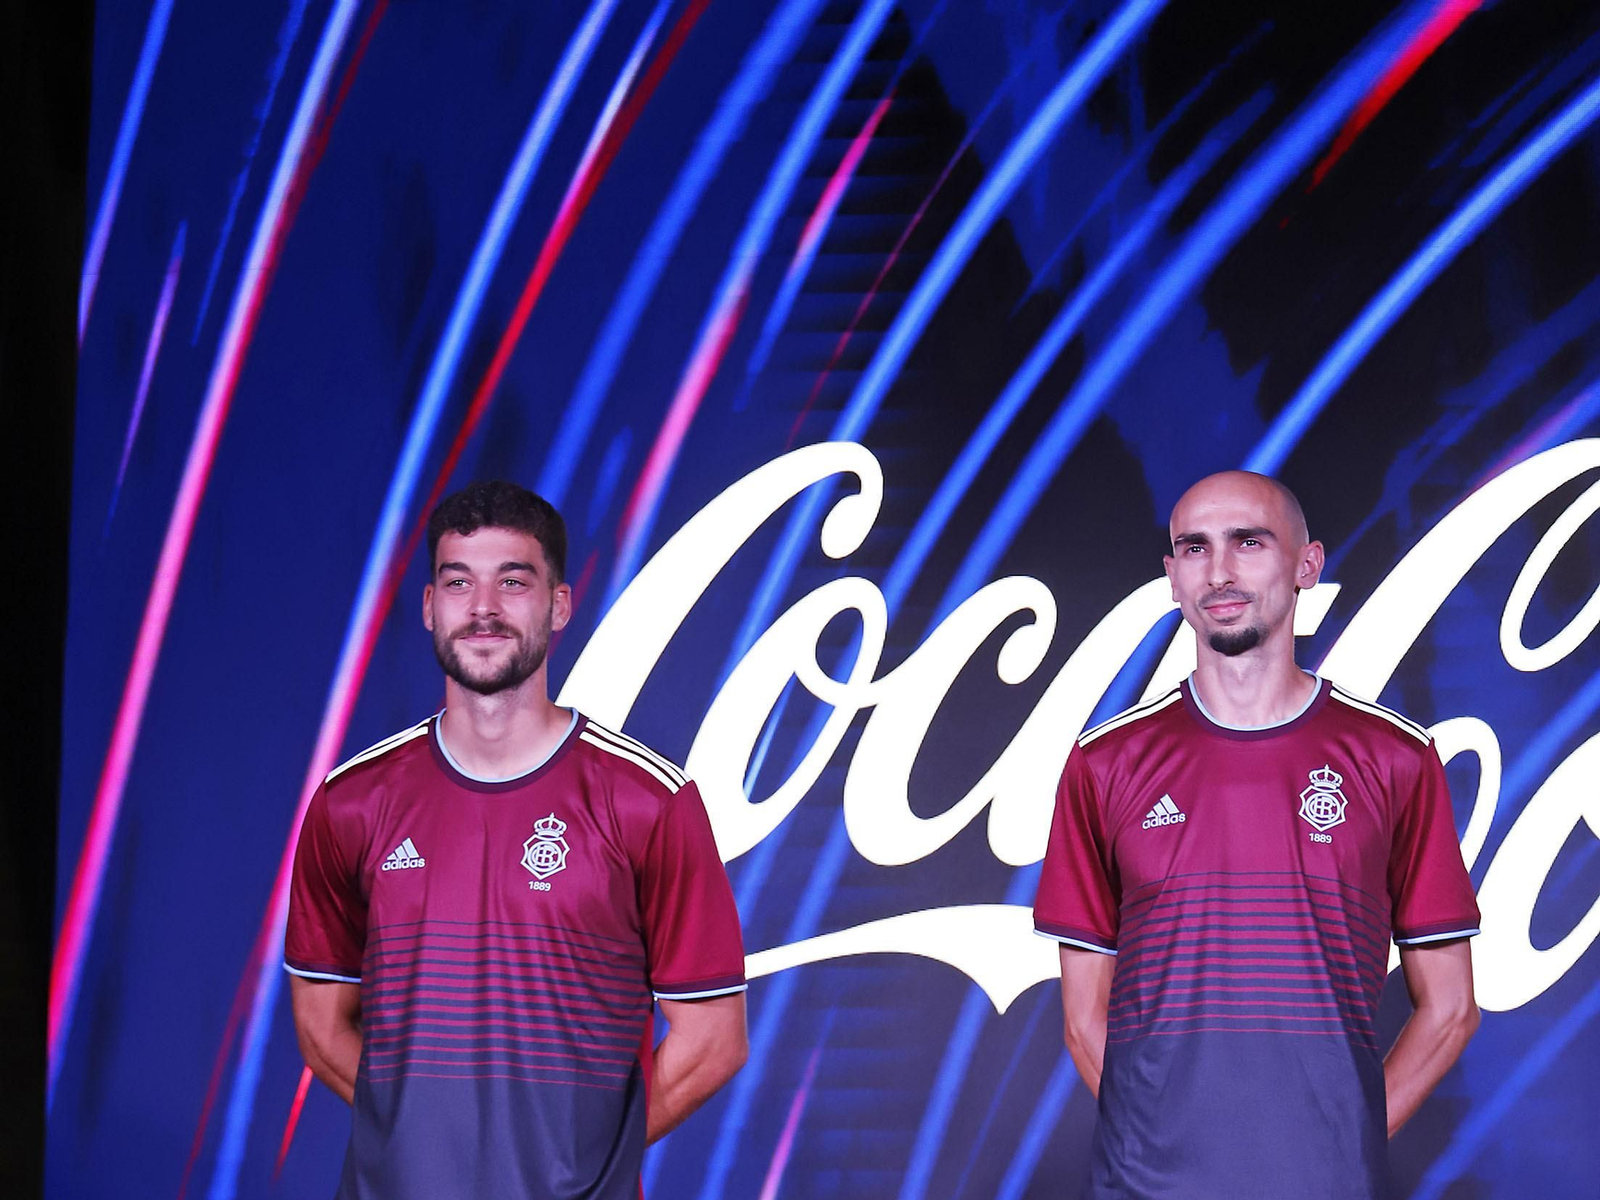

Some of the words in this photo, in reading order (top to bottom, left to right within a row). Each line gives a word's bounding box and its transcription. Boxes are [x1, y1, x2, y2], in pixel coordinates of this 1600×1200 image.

[1142, 812, 1186, 830] adidas
[1308, 833, 1332, 844] 1889
[381, 857, 426, 871] adidas
[528, 881, 552, 892] 1889
